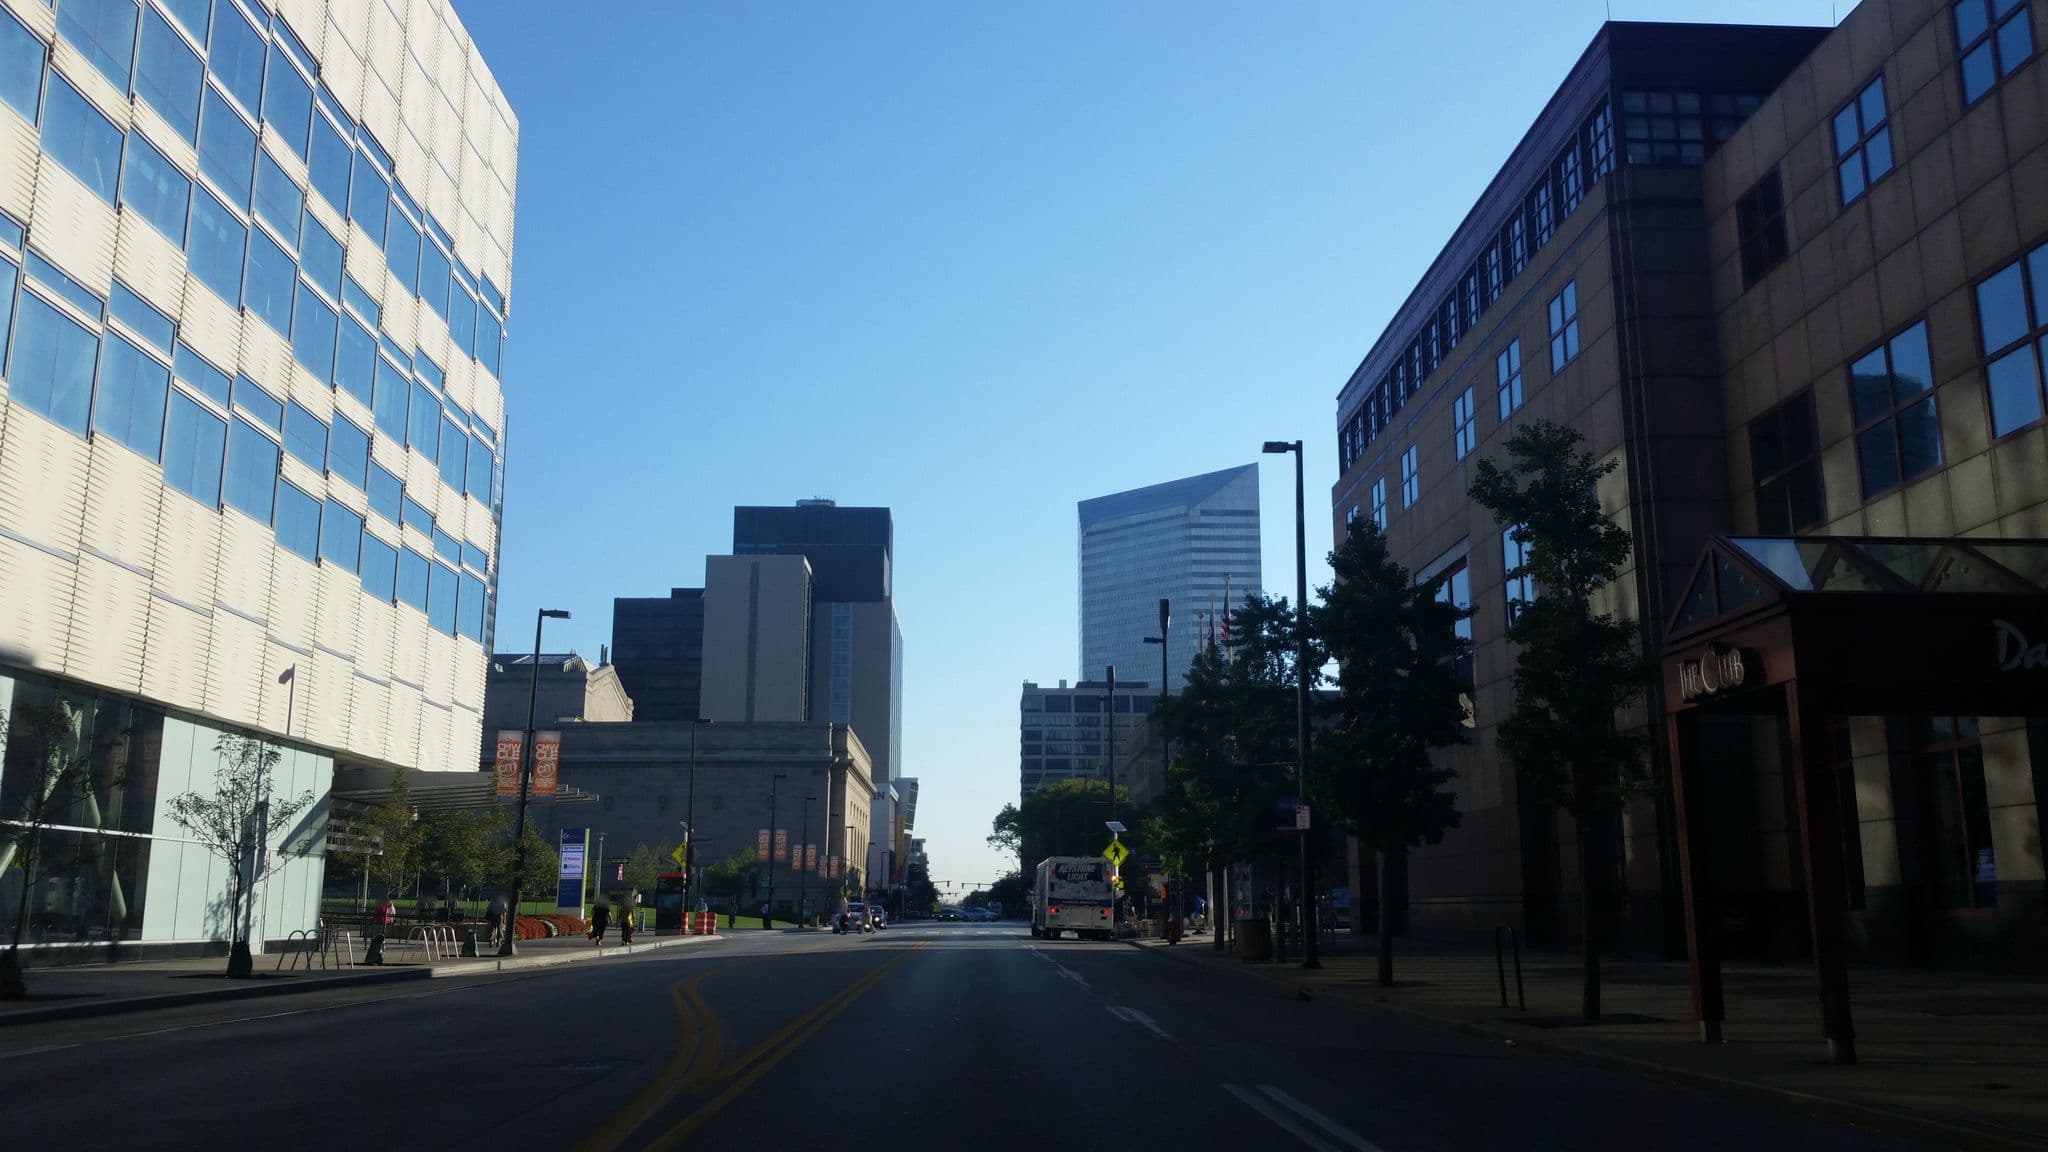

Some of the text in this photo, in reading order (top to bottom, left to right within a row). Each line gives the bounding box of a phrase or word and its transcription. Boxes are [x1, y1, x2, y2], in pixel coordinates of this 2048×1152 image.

[1679, 647, 1745, 700] THE CLUB
[535, 743, 560, 751] CMW
[496, 750, 520, 760] CLE
[535, 751, 559, 760] CLE
[1058, 863, 1097, 873] KEYSTONE
[1066, 872, 1088, 880] LIGHT
